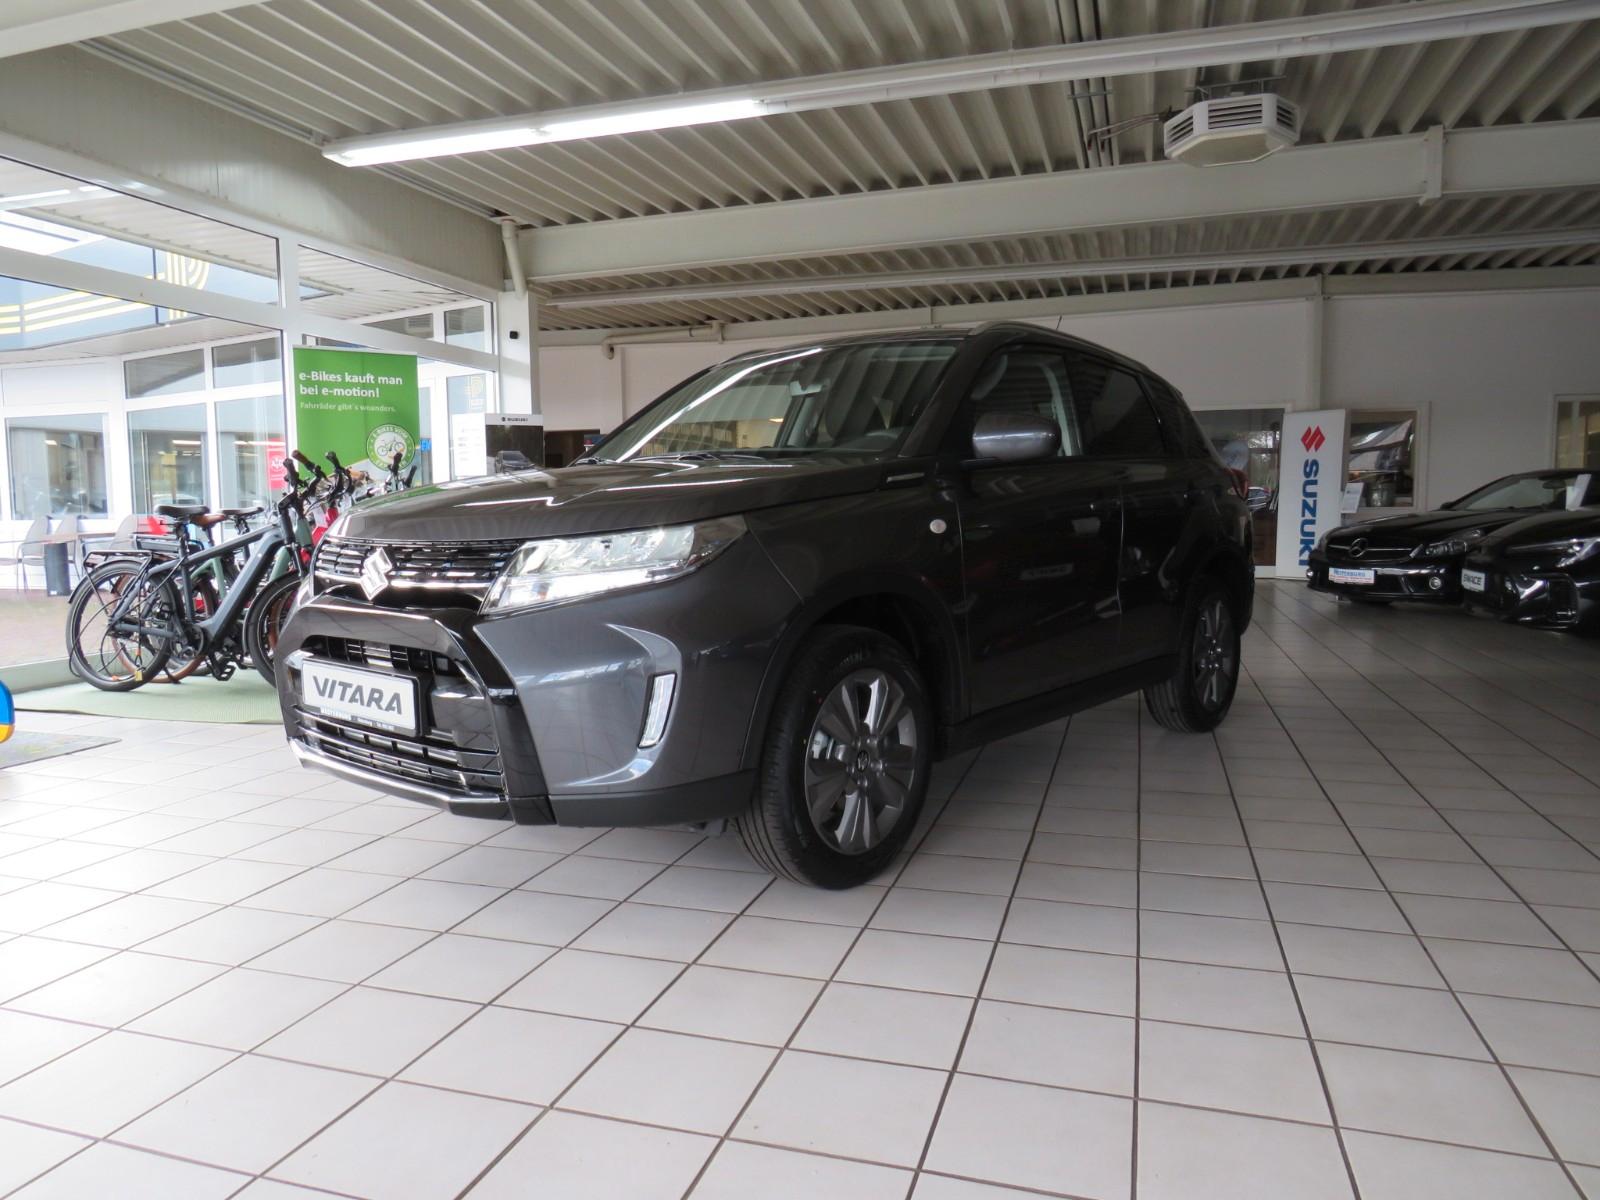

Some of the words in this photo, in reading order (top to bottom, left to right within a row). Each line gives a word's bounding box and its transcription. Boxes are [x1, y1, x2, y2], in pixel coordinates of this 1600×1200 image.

[299, 371, 342, 382] e-Bikes
[345, 372, 375, 384] kauft
[378, 376, 403, 385] man
[300, 384, 318, 395] bei
[321, 386, 380, 398] e-motion!
[1299, 458, 1320, 566] SUZUKI
[313, 675, 402, 715] VITARA
